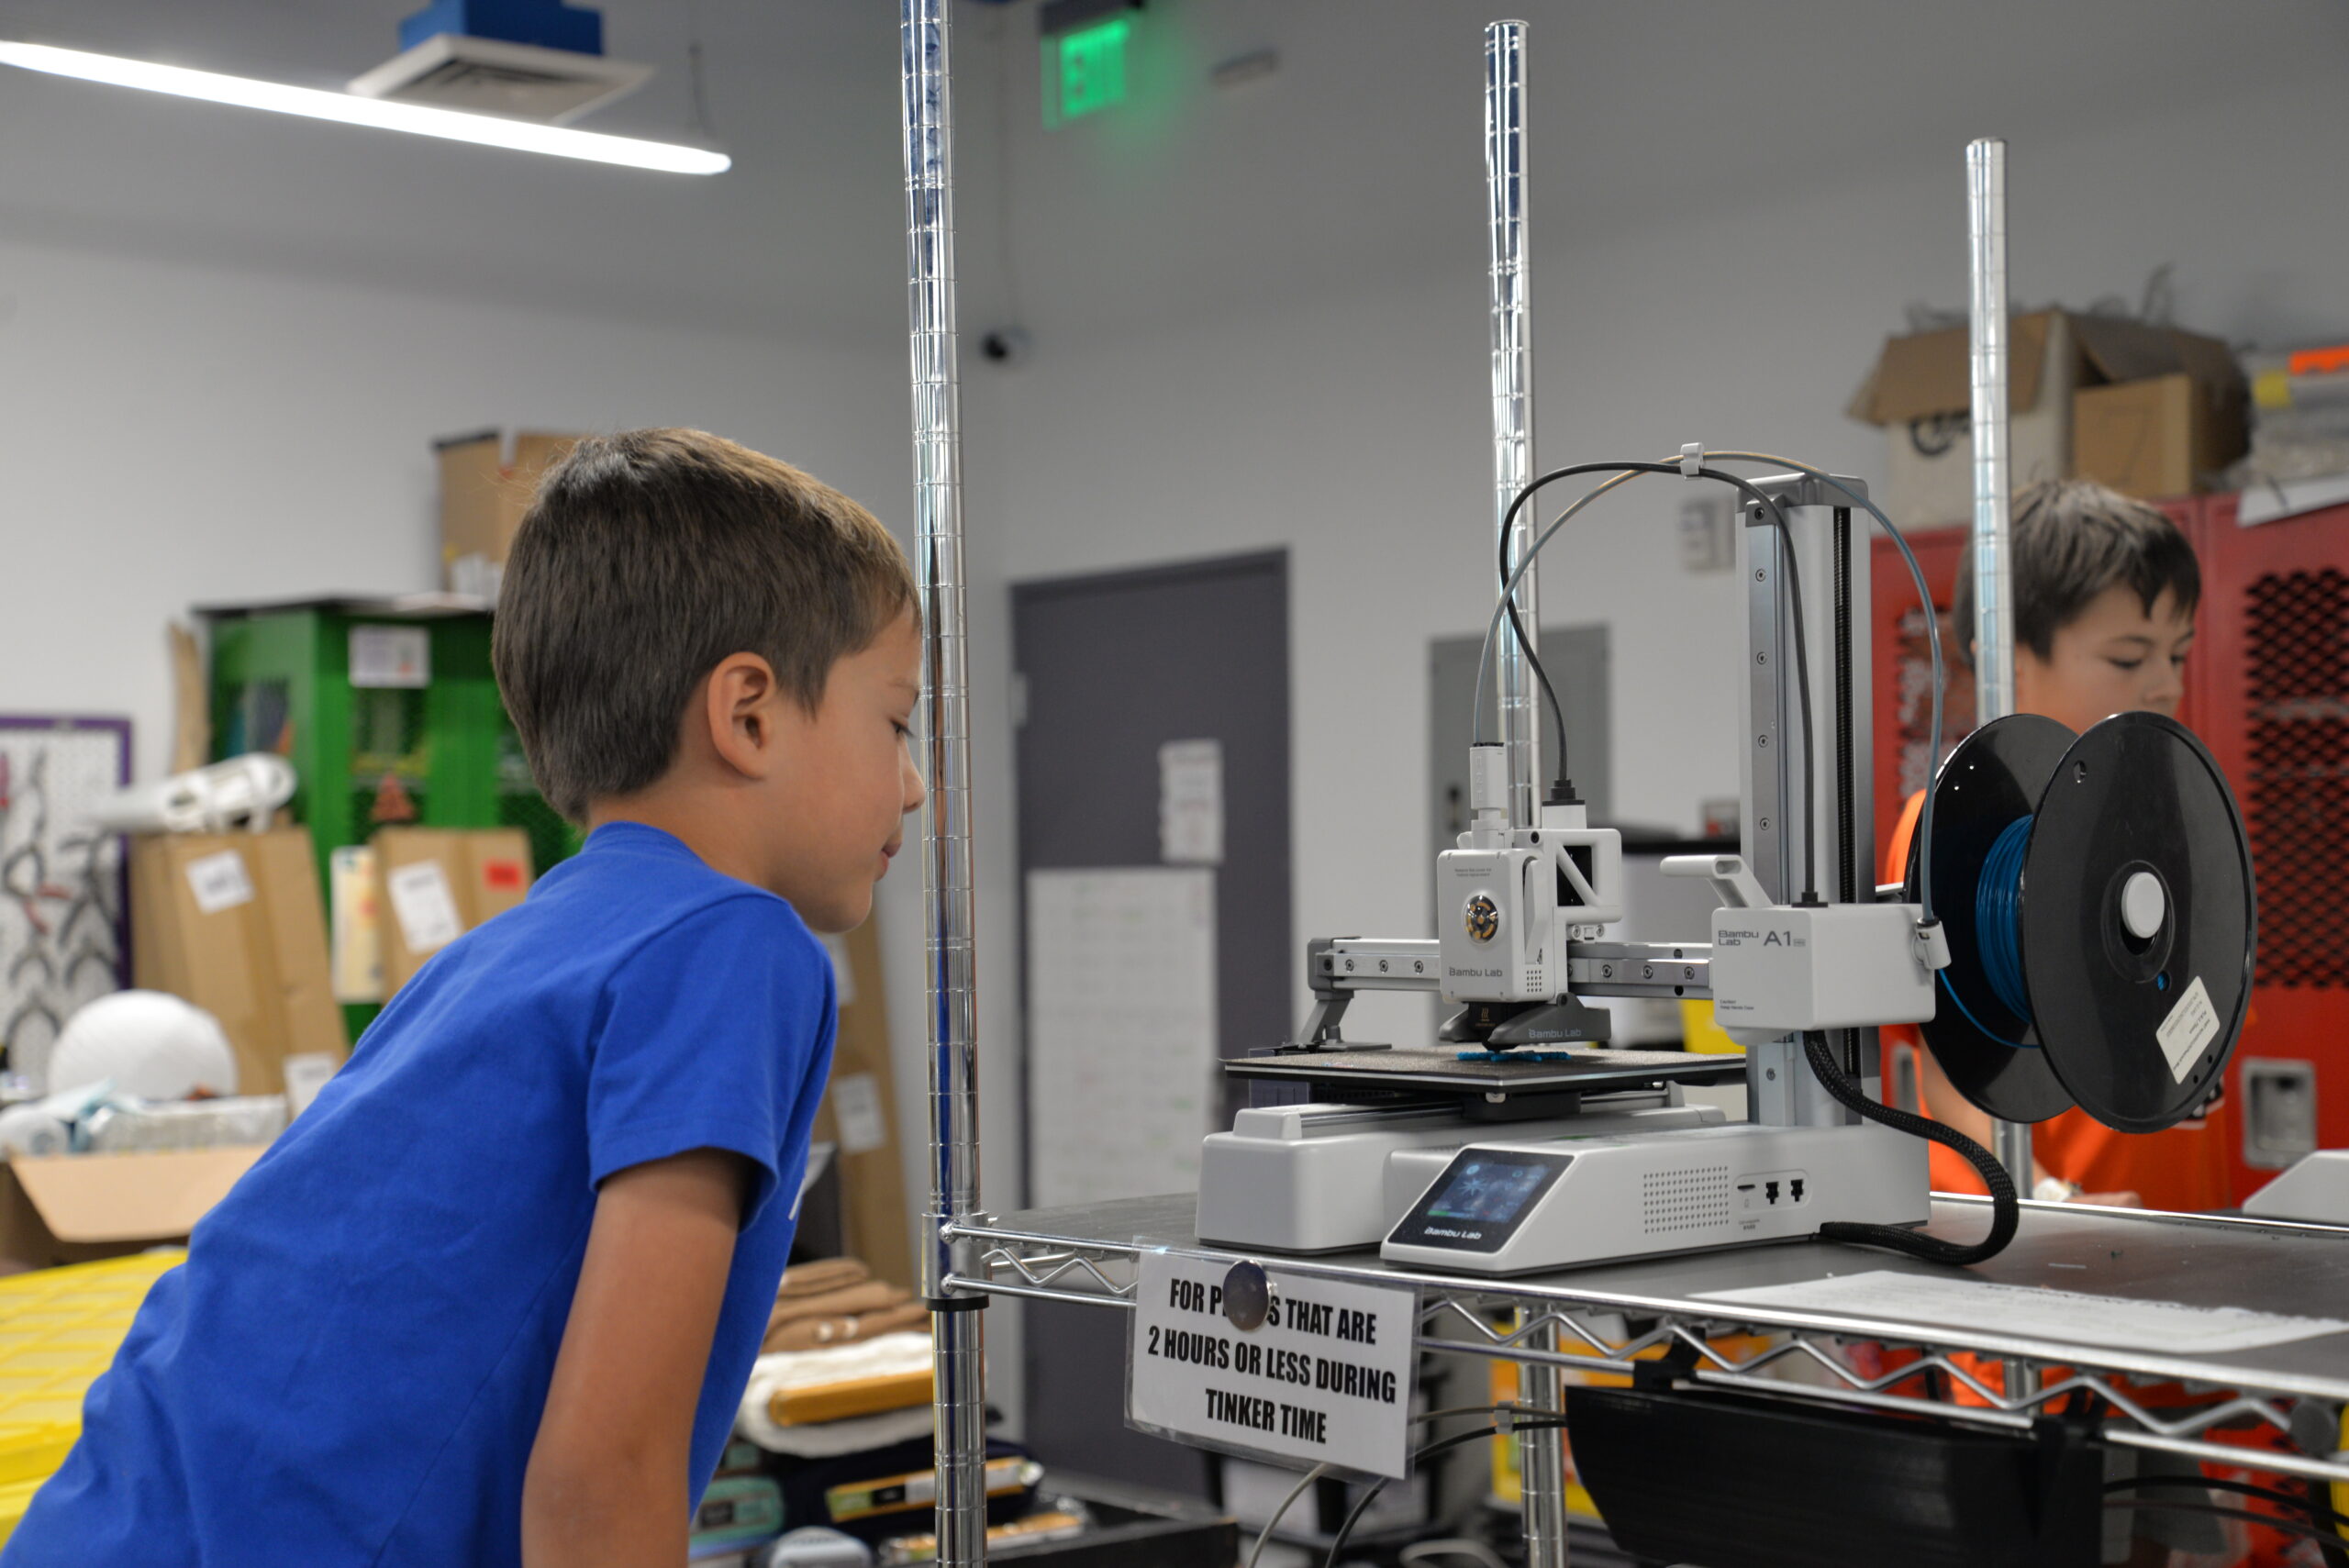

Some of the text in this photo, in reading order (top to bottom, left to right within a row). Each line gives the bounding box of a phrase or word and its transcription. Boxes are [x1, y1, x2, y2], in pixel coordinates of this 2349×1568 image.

[1718, 929, 1759, 939] Bambu
[1763, 930, 1791, 947] A1
[1718, 938, 1741, 946] Lab
[1449, 967, 1503, 977] Bambu Lab
[1529, 1028, 1582, 1039] Bambu Lab
[1424, 1226, 1482, 1240] Bambu Lab
[1170, 1278, 1204, 1313] FOR
[1286, 1299, 1333, 1336] THAT
[1336, 1309, 1376, 1345] ARE
[1148, 1325, 1397, 1404] 2 HOURS OR LESS DURING
[1205, 1388, 1327, 1444] TINKER TIME
